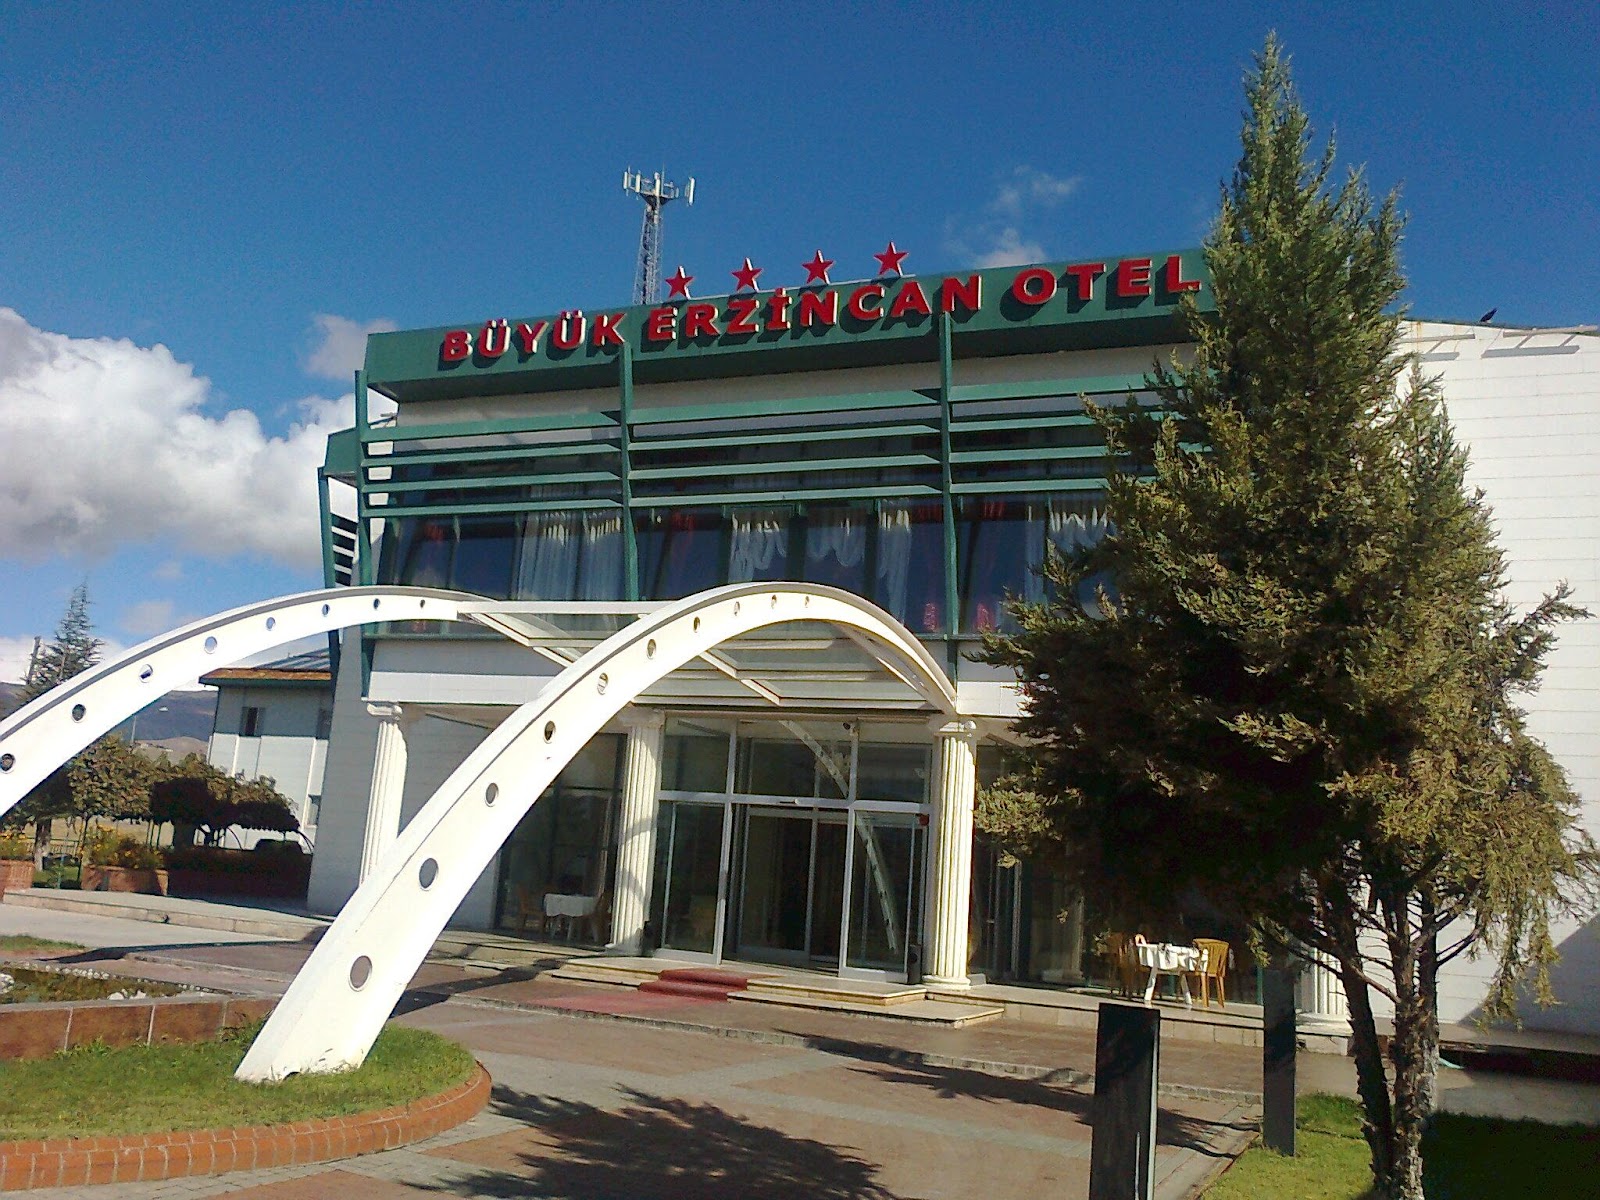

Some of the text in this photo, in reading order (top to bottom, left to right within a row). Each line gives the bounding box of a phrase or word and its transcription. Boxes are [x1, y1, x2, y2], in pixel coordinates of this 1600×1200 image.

[443, 254, 1201, 362] BÜYÜK ERZİNCAN OTEL
